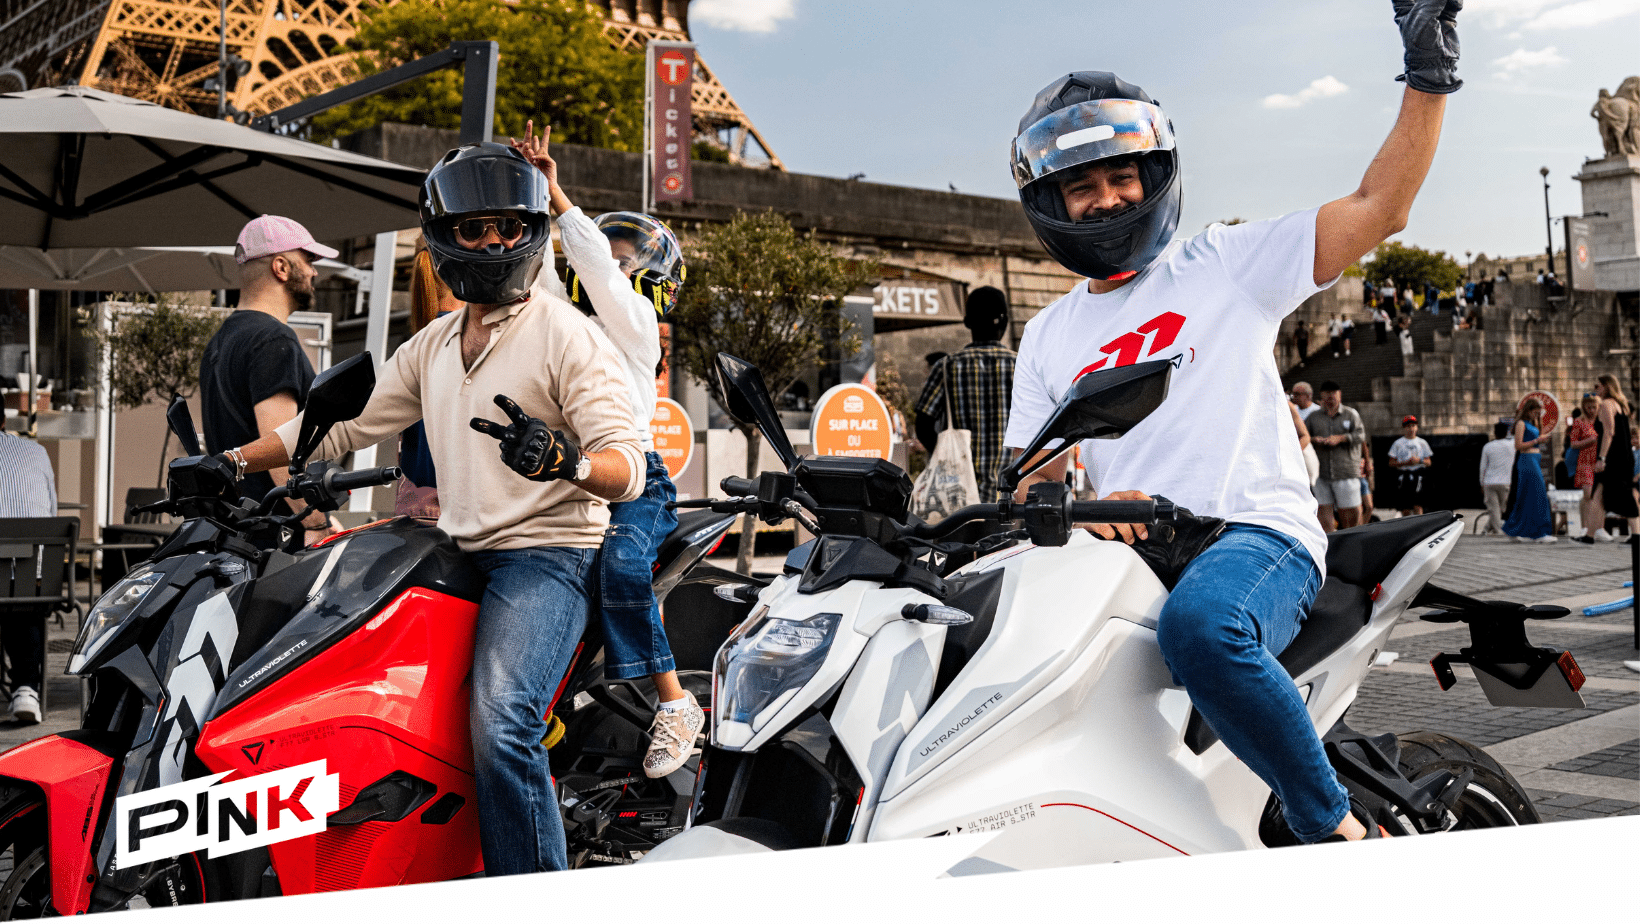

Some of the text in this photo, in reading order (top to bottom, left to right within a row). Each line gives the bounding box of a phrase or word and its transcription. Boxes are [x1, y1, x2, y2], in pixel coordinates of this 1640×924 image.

[658, 425, 682, 435] PLACE
[828, 418, 878, 431] SUR PLACE
[847, 434, 861, 447] OU
[238, 639, 308, 688] ULTRAVIOLETTE
[279, 725, 334, 743] ULTRAVIOLETTE
[919, 692, 1003, 757] ULTRAVIOLETTE
[967, 802, 1034, 830] ULTRAVIOLETTE
[990, 820, 1006, 831] AIR
[1010, 810, 1036, 825] S_STR
